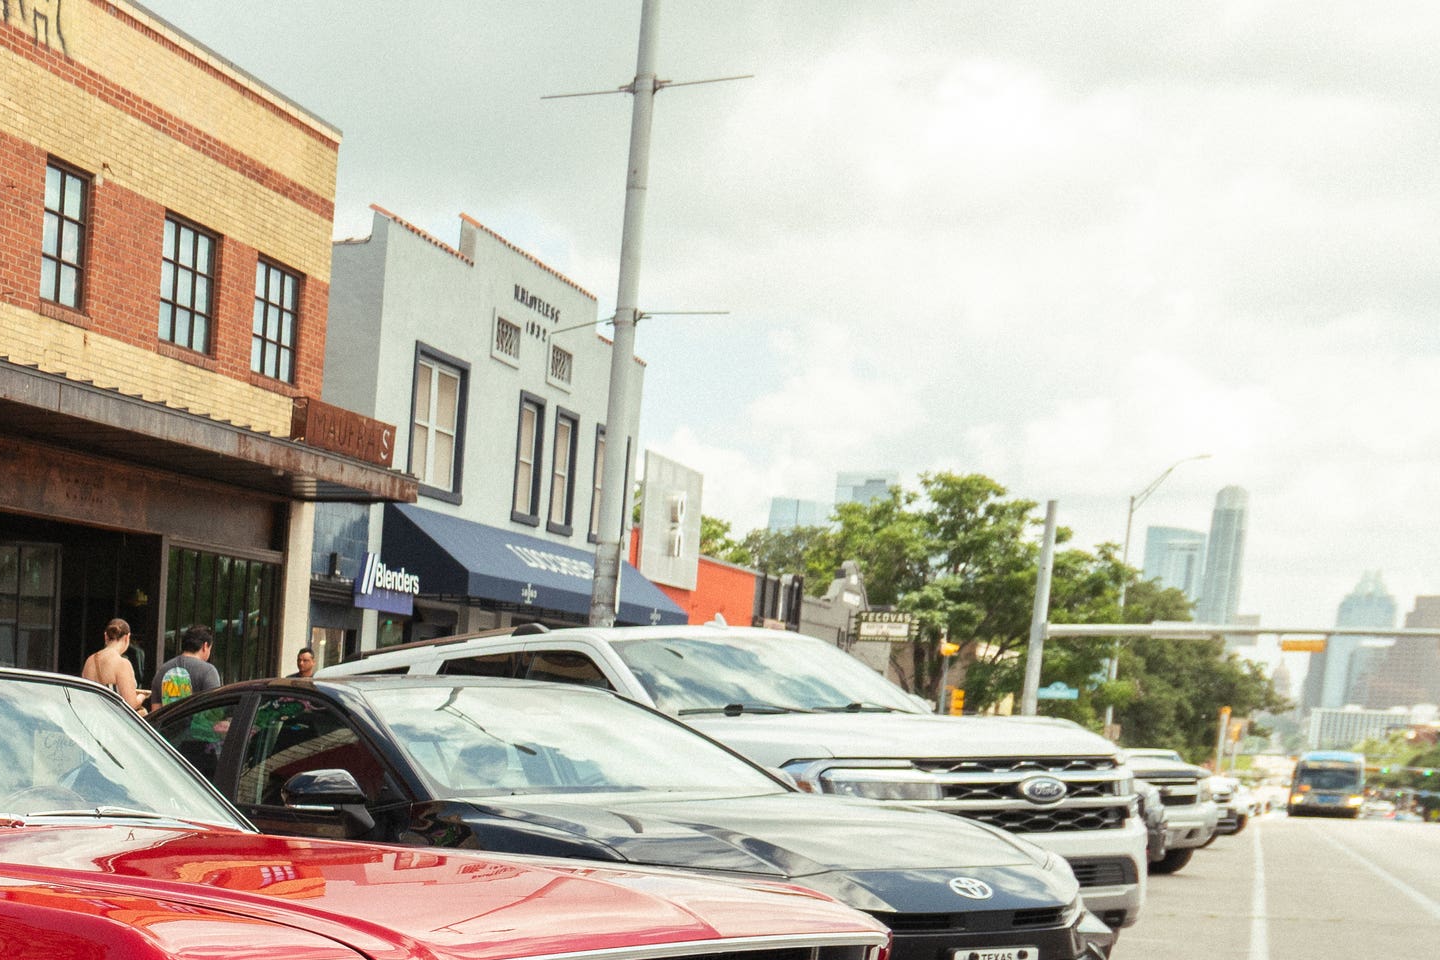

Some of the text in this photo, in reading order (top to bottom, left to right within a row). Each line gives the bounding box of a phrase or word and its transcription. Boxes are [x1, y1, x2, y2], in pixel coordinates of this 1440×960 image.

[525, 319, 547, 342] 1932
[375, 562, 420, 595] Blenders
[860, 612, 912, 623] TECOVAS
